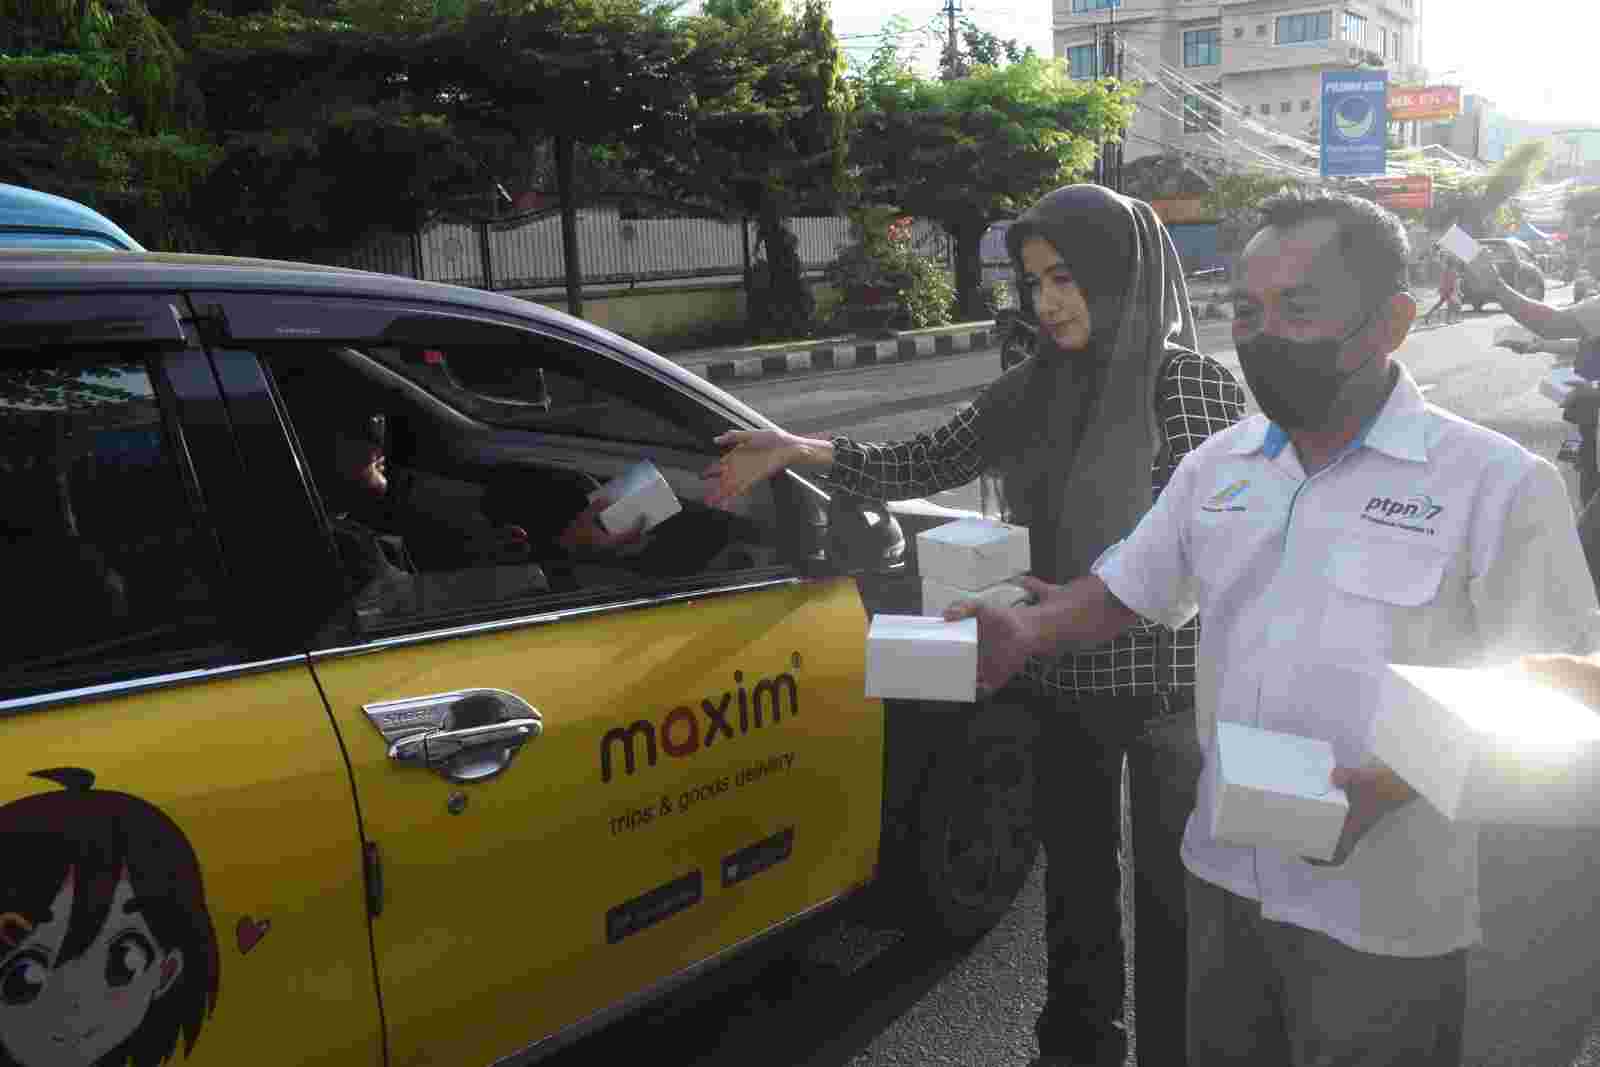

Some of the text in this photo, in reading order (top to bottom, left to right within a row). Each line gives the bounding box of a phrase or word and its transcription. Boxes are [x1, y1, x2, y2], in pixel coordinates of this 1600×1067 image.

[1365, 496, 1419, 517] ptpn
[600, 669, 798, 783] maxim
[608, 806, 656, 837] trips
[659, 795, 674, 816] &
[679, 776, 730, 813] goods
